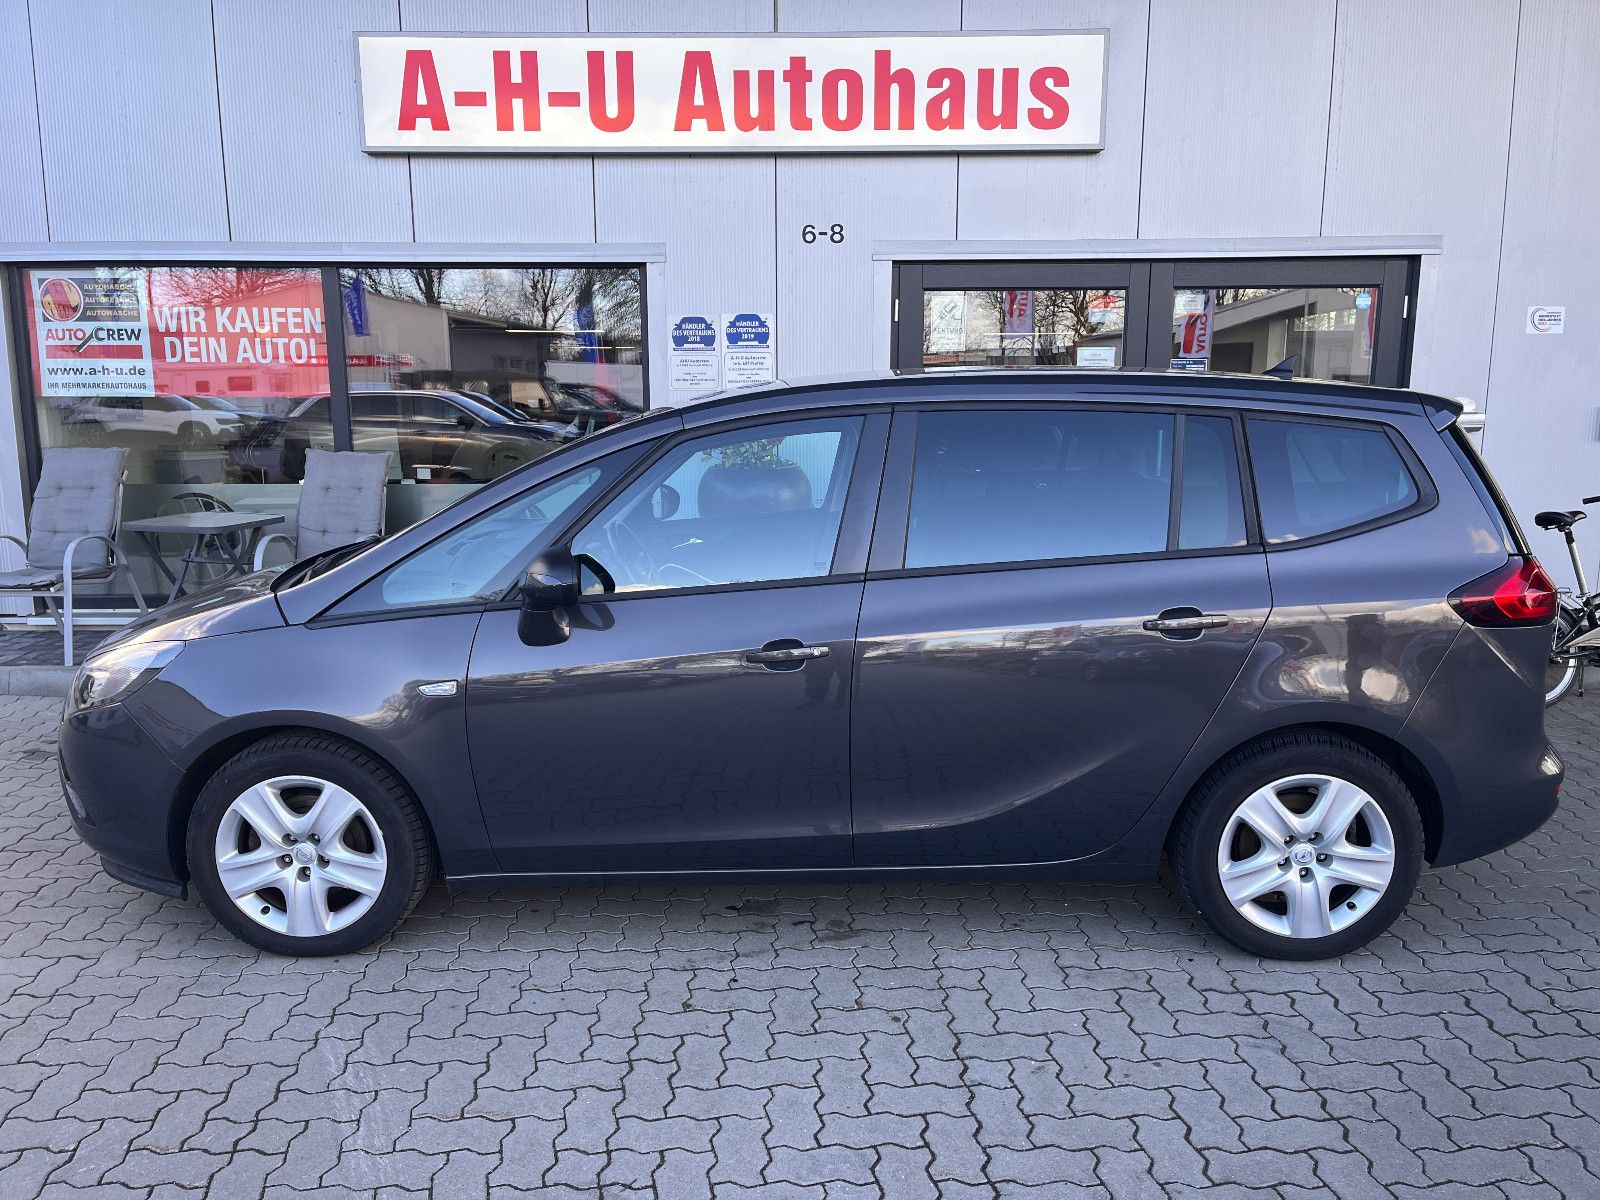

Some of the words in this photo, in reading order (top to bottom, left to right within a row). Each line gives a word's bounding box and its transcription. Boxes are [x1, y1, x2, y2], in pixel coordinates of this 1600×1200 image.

[398, 50, 636, 133] A-H-U
[673, 50, 1070, 132] Autohaus
[802, 224, 844, 244] 6-8
[152, 306, 207, 333] WIR
[215, 307, 322, 334] KAUFEN
[45, 328, 87, 341] AUTO
[93, 327, 142, 341] CREW
[164, 336, 227, 363] DEIN
[237, 337, 317, 364] AUTO!
[47, 366, 146, 376] www.a-h-u.de
